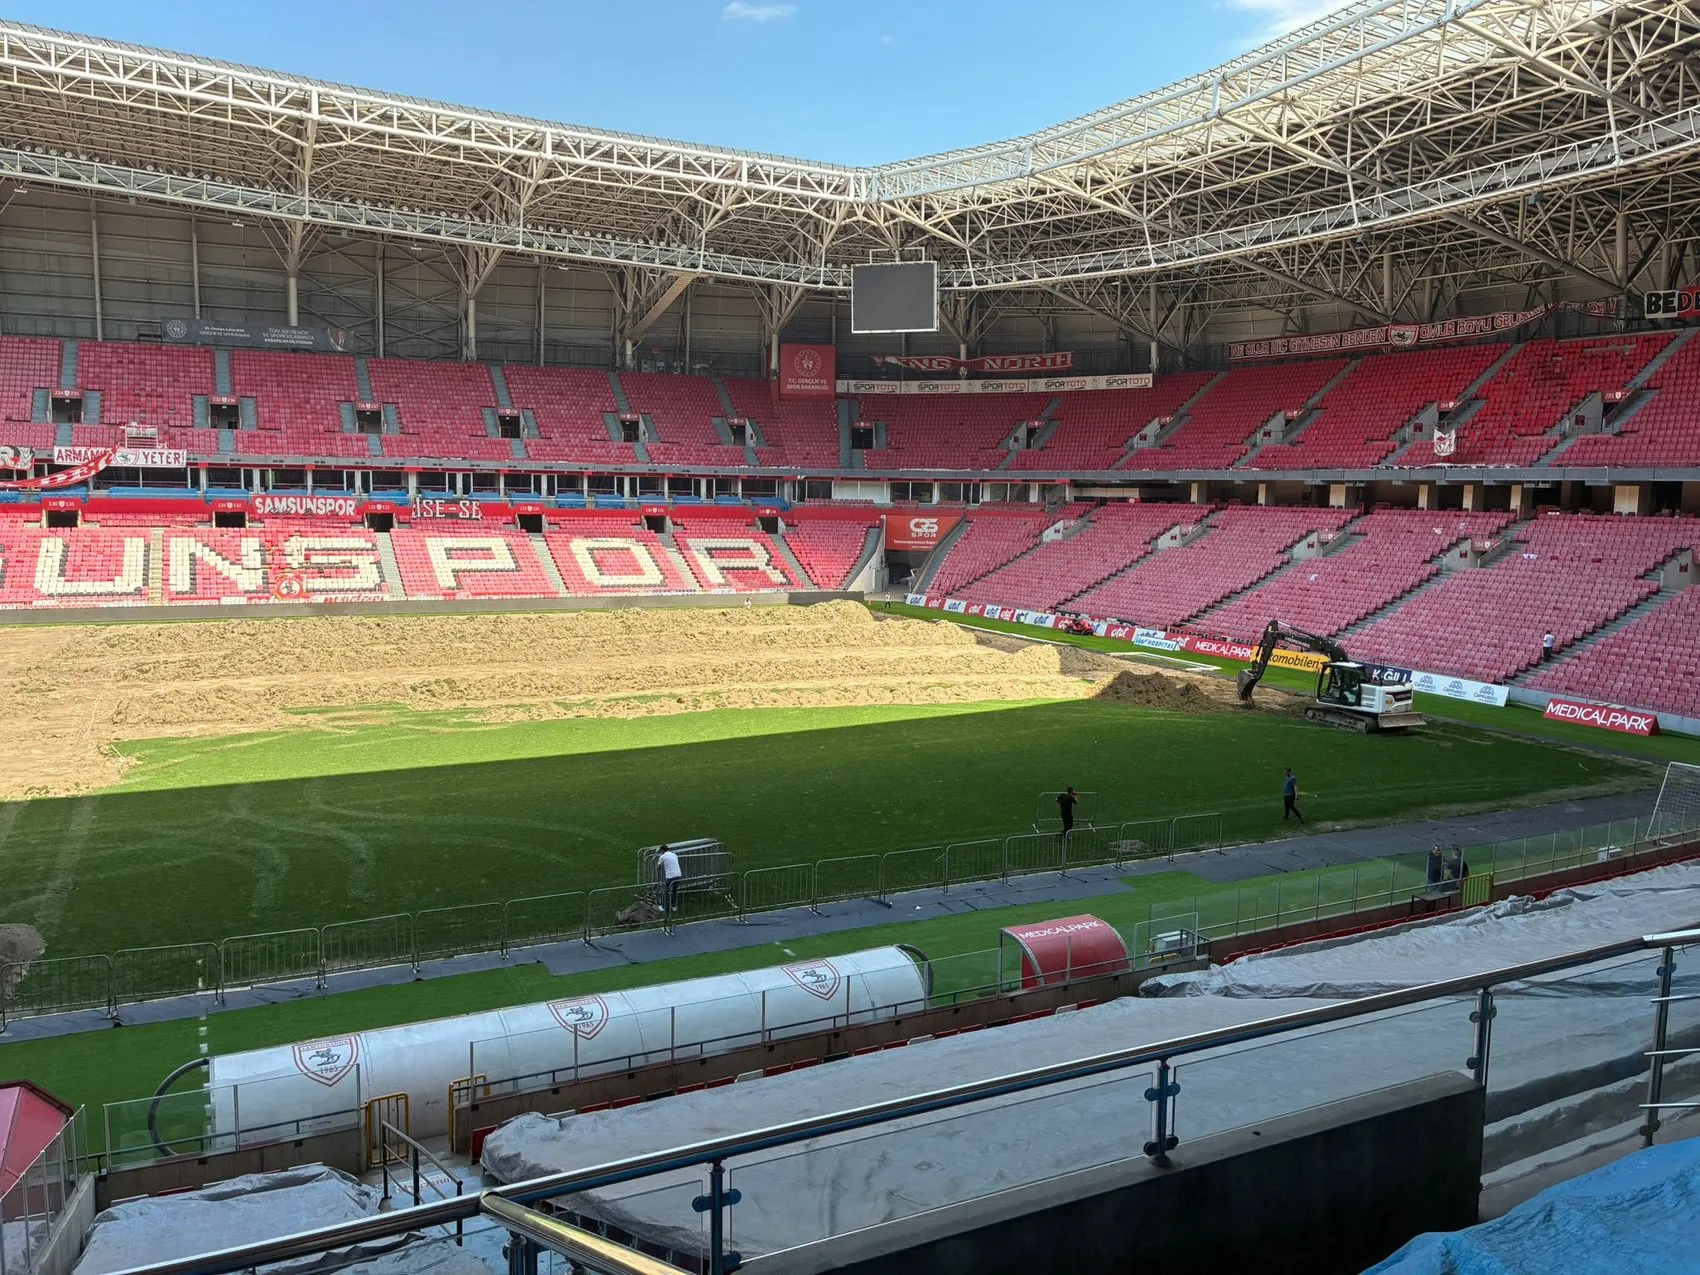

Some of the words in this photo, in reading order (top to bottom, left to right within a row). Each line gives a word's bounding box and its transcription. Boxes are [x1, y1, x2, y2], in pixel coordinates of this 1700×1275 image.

[1456, 317, 1492, 334] BOYU
[984, 354, 1072, 370] NORTH
[142, 450, 185, 464] YETER!
[255, 497, 355, 516] SAMSUNSPOR
[1147, 640, 1175, 649] HOSPITAL
